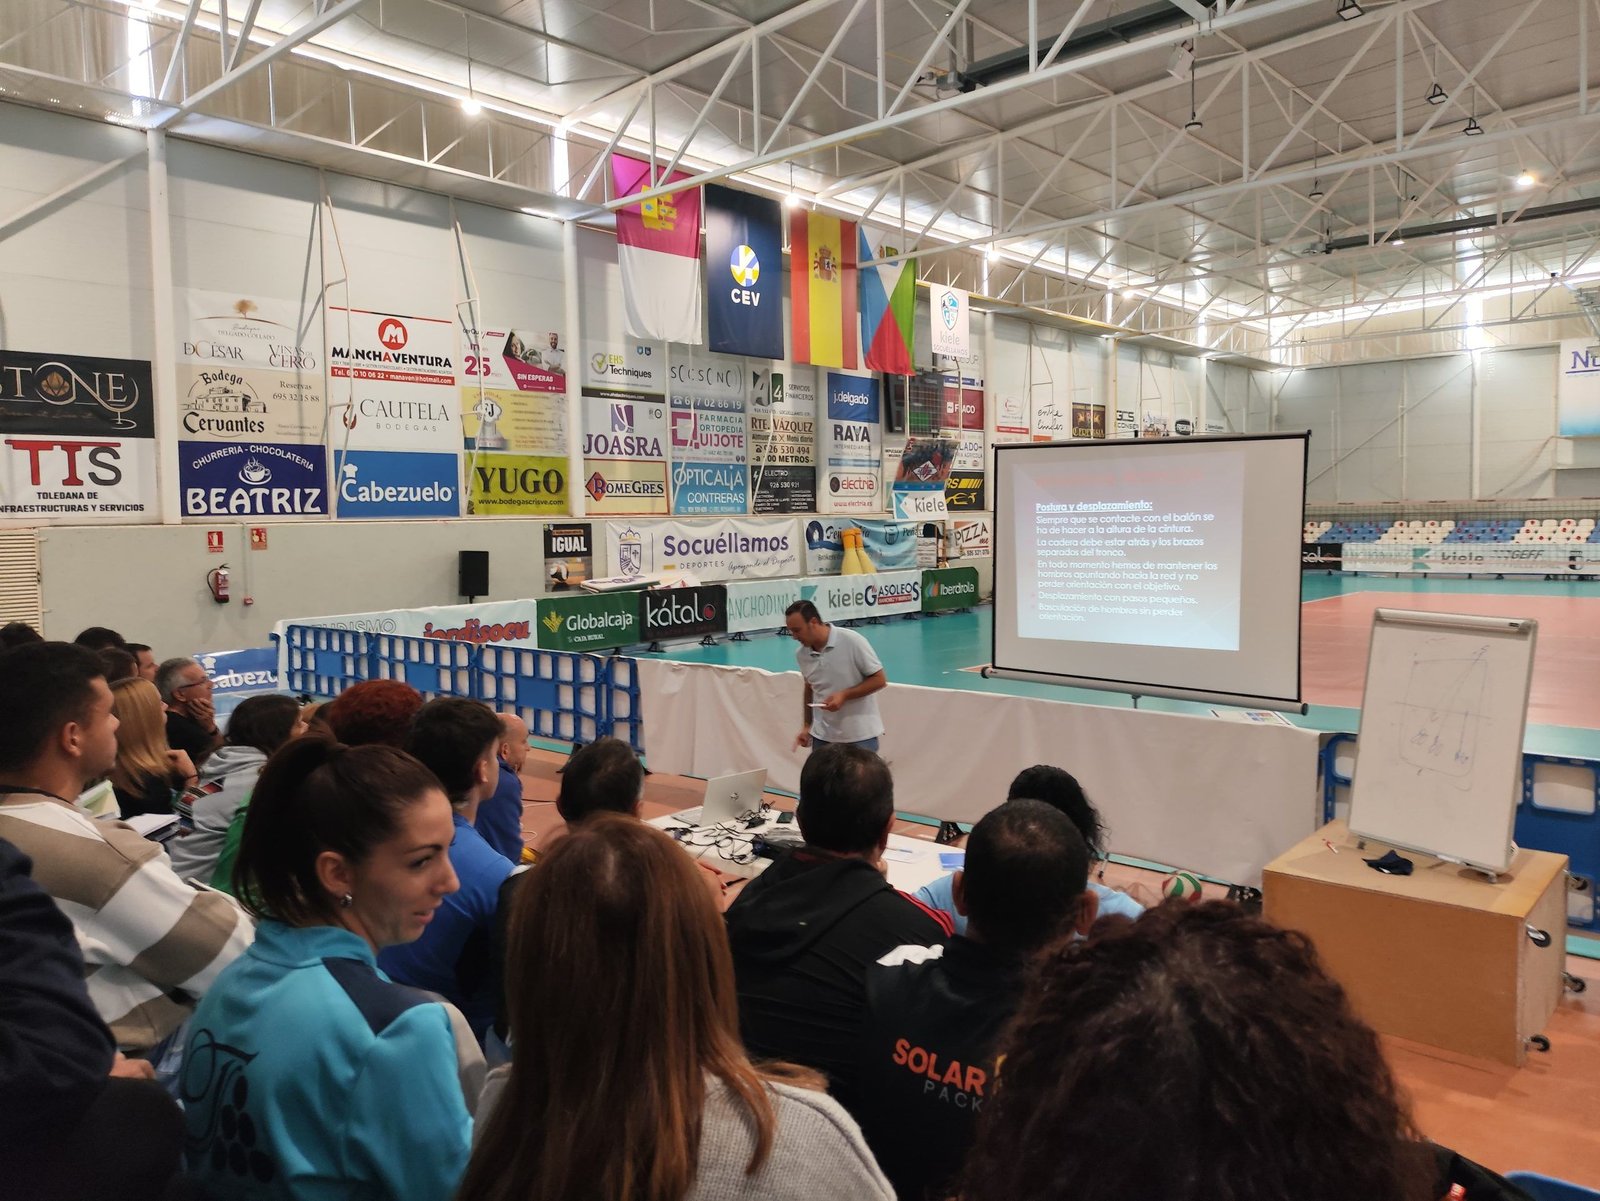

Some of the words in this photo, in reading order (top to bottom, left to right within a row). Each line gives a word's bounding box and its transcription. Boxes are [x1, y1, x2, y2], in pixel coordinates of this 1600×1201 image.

[731, 288, 761, 307] CEV
[331, 346, 452, 368] MANCHAVENTURA
[199, 369, 244, 386] Bodega
[528, 374, 554, 383] ESPERAS
[609, 364, 652, 379] Techniques
[279, 380, 312, 390] Reservas
[360, 398, 450, 421] CAUTELA
[182, 411, 265, 434] Cervantes
[700, 413, 743, 424] FARMACIA
[773, 417, 814, 433] VÁZQUEZ
[376, 422, 437, 432] BODEGAS
[700, 424, 743, 433] ORTOPEDIA
[833, 424, 871, 443] RAYA
[582, 433, 663, 457] JOASRA
[780, 445, 795, 454] 530
[796, 446, 810, 455] 494
[5, 439, 122, 487] TIS
[192, 445, 244, 470] CHURRERIA
[249, 444, 314, 472] CHOCOLATERIA
[475, 467, 564, 495] YUGO
[673, 465, 745, 491] OPTICALIA
[841, 476, 875, 490] electria
[36, 491, 85, 500] TOLEDANA
[87, 492, 99, 500] DE
[341, 478, 453, 502] Cabezuelo
[687, 492, 745, 504] CONTRERAS
[99, 504, 145, 512] SERVICIOS
[186, 487, 322, 514] BEATRIZ
[478, 498, 565, 507] www.bodegascrisve.com
[914, 496, 946, 515] kiele
[1036, 502, 1067, 511] Postura
[1076, 500, 1153, 511] desplazamiento:
[1036, 516, 1069, 525] Siempre
[1070, 517, 1087, 525] que
[1162, 512, 1172, 521] el
[1173, 512, 1202, 522] balón
[955, 521, 989, 547] PIZZA
[1036, 526, 1048, 534] ha
[1048, 526, 1060, 534] de
[1062, 526, 1086, 534] hacer
[1096, 525, 1105, 534] la
[1106, 525, 1132, 534] altura
[1132, 525, 1146, 533] de
[1147, 525, 1156, 533] la
[1158, 524, 1194, 533] cintura.
[552, 536, 588, 553] IGUAL
[663, 532, 790, 557] Socuéllamos
[1048, 538, 1078, 546] cadera
[1080, 538, 1103, 546] debe
[1104, 538, 1126, 546] estar
[1127, 537, 1150, 546] atrás
[1151, 540, 1158, 548] y
[1158, 538, 1171, 546] los
[1172, 538, 1205, 546] brazos
[1036, 548, 1079, 558] separados
[1096, 548, 1127, 556] tronco.
[679, 560, 725, 570] DEPORTES
[1038, 560, 1047, 568] En
[1049, 560, 1068, 568] todo
[1070, 561, 1110, 569] momento
[1112, 561, 1141, 569] hemos
[1142, 560, 1155, 570] de
[1156, 561, 1204, 570] mantener
[1204, 562, 1218, 570] los
[828, 588, 864, 609] kiele
[864, 581, 920, 607] GASOLEOS
[939, 581, 975, 596] Iberdrola
[566, 610, 633, 632] Globalcaja
[892, 1037, 987, 1097] SOLAR
[923, 1079, 984, 1113] PACK
